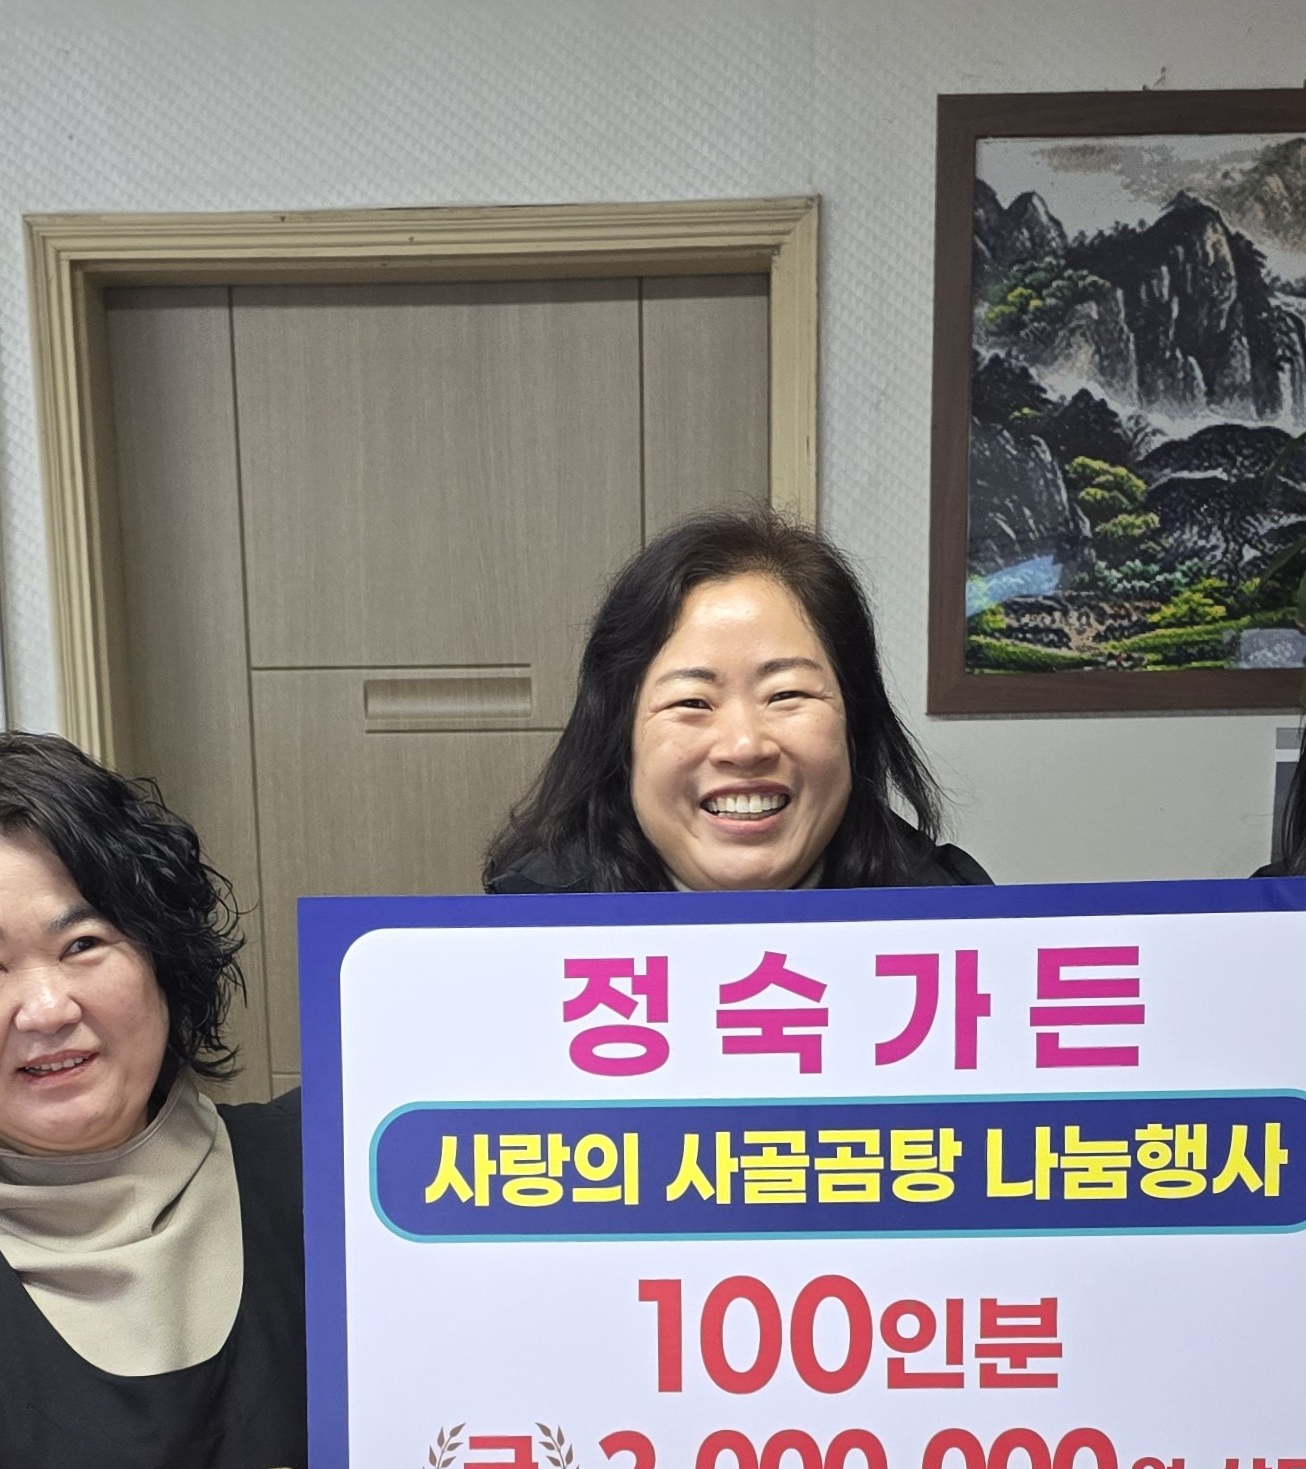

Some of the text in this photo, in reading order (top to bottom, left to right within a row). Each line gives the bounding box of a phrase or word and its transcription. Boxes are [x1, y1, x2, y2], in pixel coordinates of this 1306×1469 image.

[563, 946, 1145, 1076] 정숙가든
[425, 1122, 1288, 1207] 사랑의 사골곰탕 나눔행사
[638, 1274, 1064, 1395] 100인분
